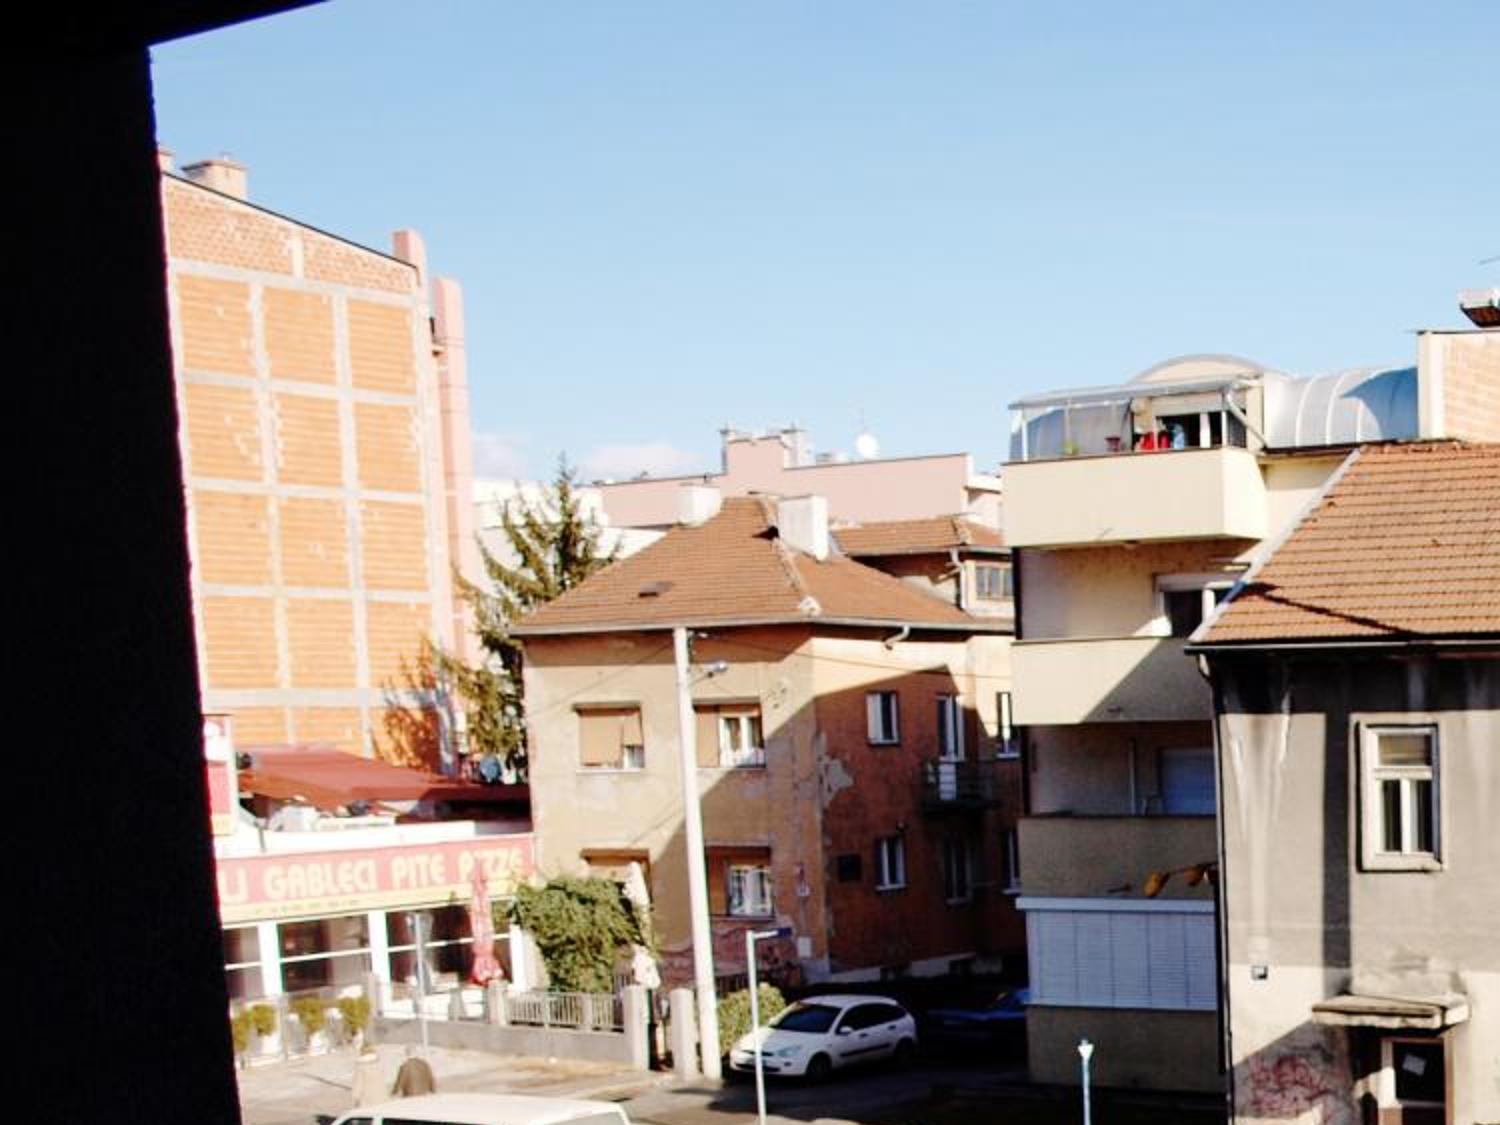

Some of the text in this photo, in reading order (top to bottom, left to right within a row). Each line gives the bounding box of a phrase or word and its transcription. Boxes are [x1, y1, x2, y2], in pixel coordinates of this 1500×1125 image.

[264, 858, 377, 900] GABLECI
[392, 852, 446, 890] PITE
[458, 846, 524, 883] PZZE
